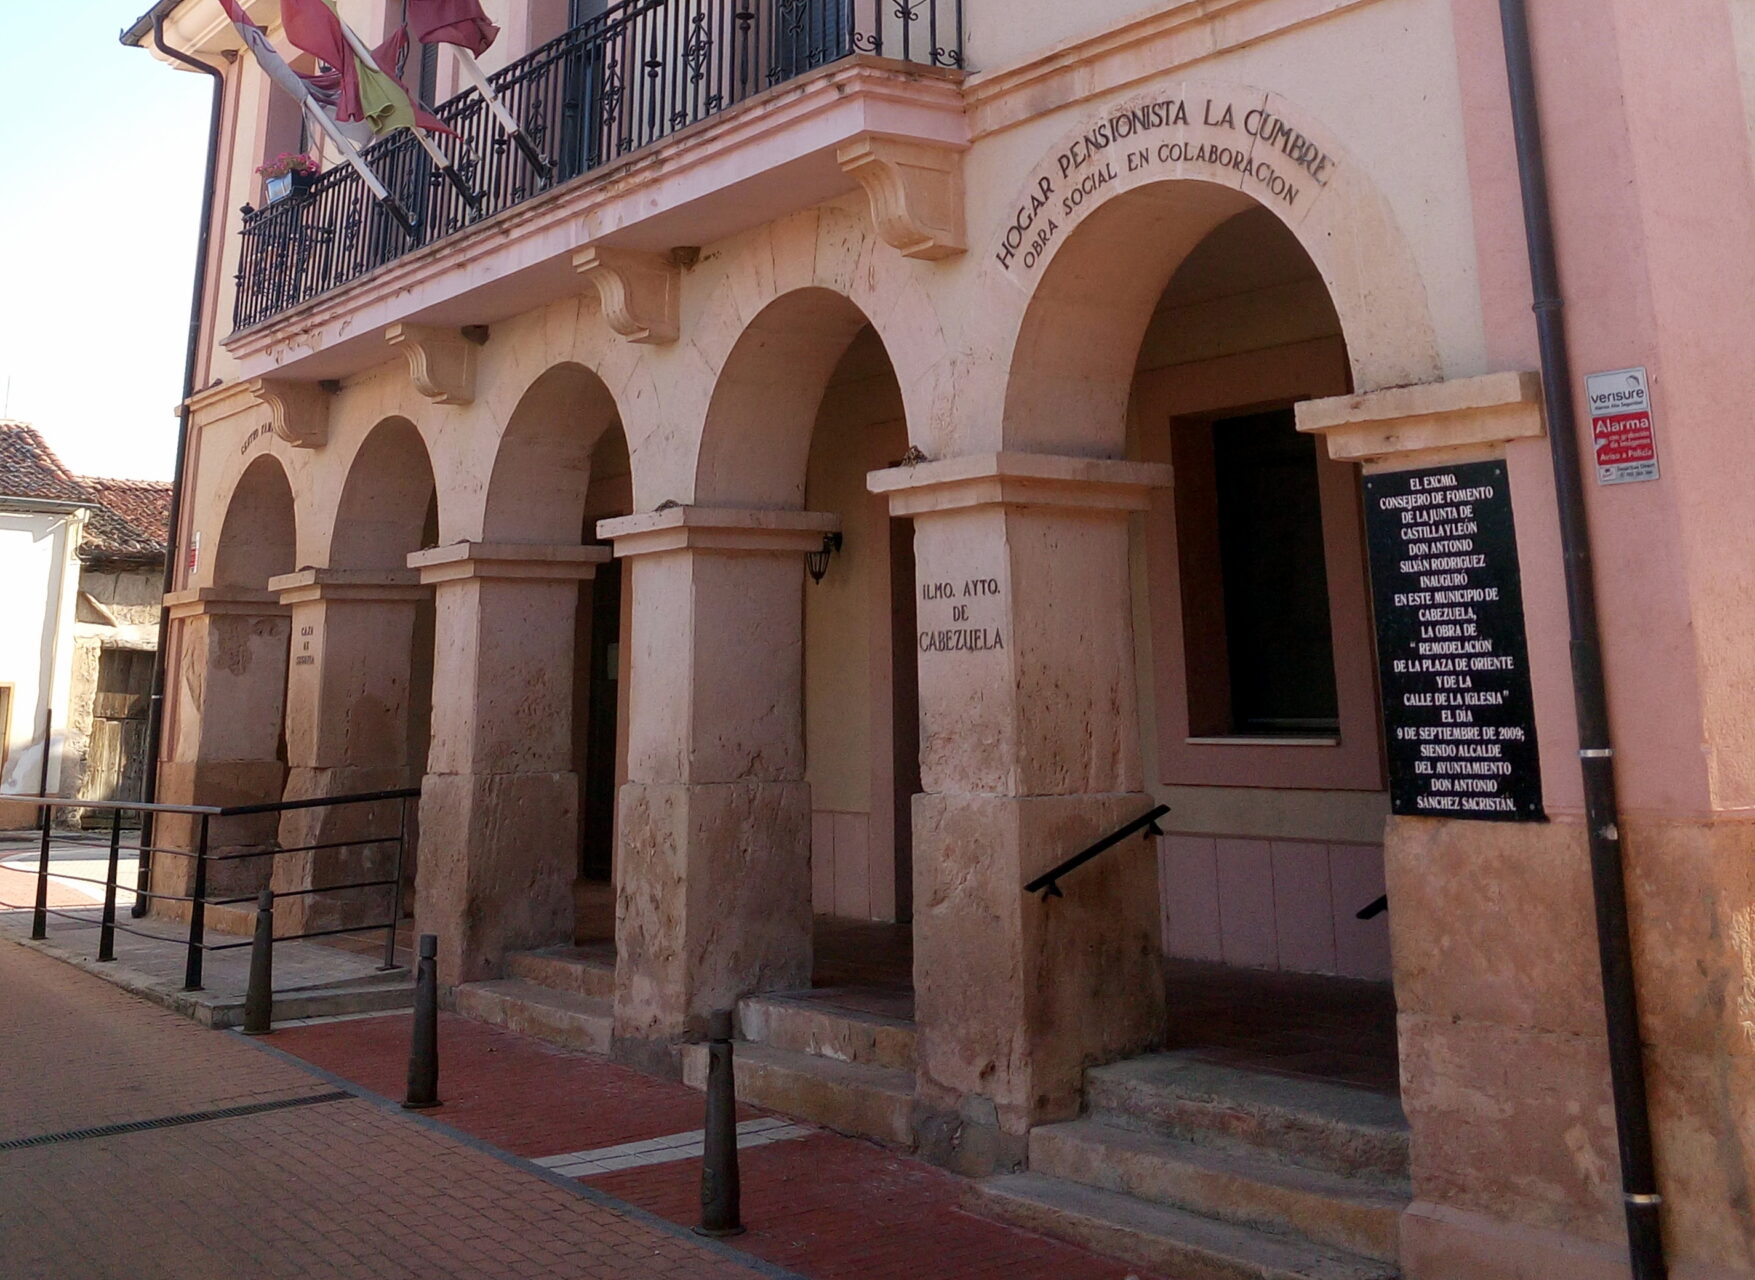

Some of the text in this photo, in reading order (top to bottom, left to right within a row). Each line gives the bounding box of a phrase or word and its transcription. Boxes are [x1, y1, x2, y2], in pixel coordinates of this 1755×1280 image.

[996, 99, 1336, 270] HOGAR PENSIONISTA LA CUMBRE
[1023, 142, 1299, 269] OBRA SOCIAL EN COLABORACION
[1591, 388, 1644, 404] verisure
[1595, 418, 1649, 434] Alarma
[1410, 474, 1457, 490] EL EXCMO.
[1380, 486, 1493, 509] CONSEJERO DE FOMENTO
[1401, 505, 1473, 523] DE LA JUNTA DE
[1401, 519, 1477, 539] CASTILLA Y LEÓN
[1409, 539, 1473, 556] DON ANTONIO
[1400, 555, 1486, 573] SILVÁN RODRIGUEZ
[1420, 570, 1468, 588] INAUGURÓ
[922, 578, 1000, 600] ILMO. AYTO.
[1394, 588, 1499, 606] EN ESTE MUNICIPIO DE
[953, 604, 969, 622] DE
[1419, 607, 1477, 621] CABEZUELA,
[919, 627, 1004, 652] CABEZUELA
[1421, 624, 1477, 638] LA OBRA DE
[1418, 637, 1492, 655] REMODELACIÓN
[1394, 656, 1514, 672] DE LA PLAZA DE ORIENTE
[1436, 675, 1472, 688] Y DE LA
[1403, 693, 1433, 706] CALLE
[1435, 693, 1448, 705] DE
[1450, 693, 1463, 705] LA
[1441, 706, 1473, 722] EL DÍA
[1397, 727, 1525, 742] 9 DE SEPTIEMBRE DE 2009;
[1420, 744, 1502, 757] SIENDO ALCALDE
[1415, 761, 1511, 775] DEL AYUNTAMIENTO
[1431, 778, 1497, 792] DON ANTONIO
[1417, 793, 1516, 811] SÁNCHEZ SACRISTÁN.
